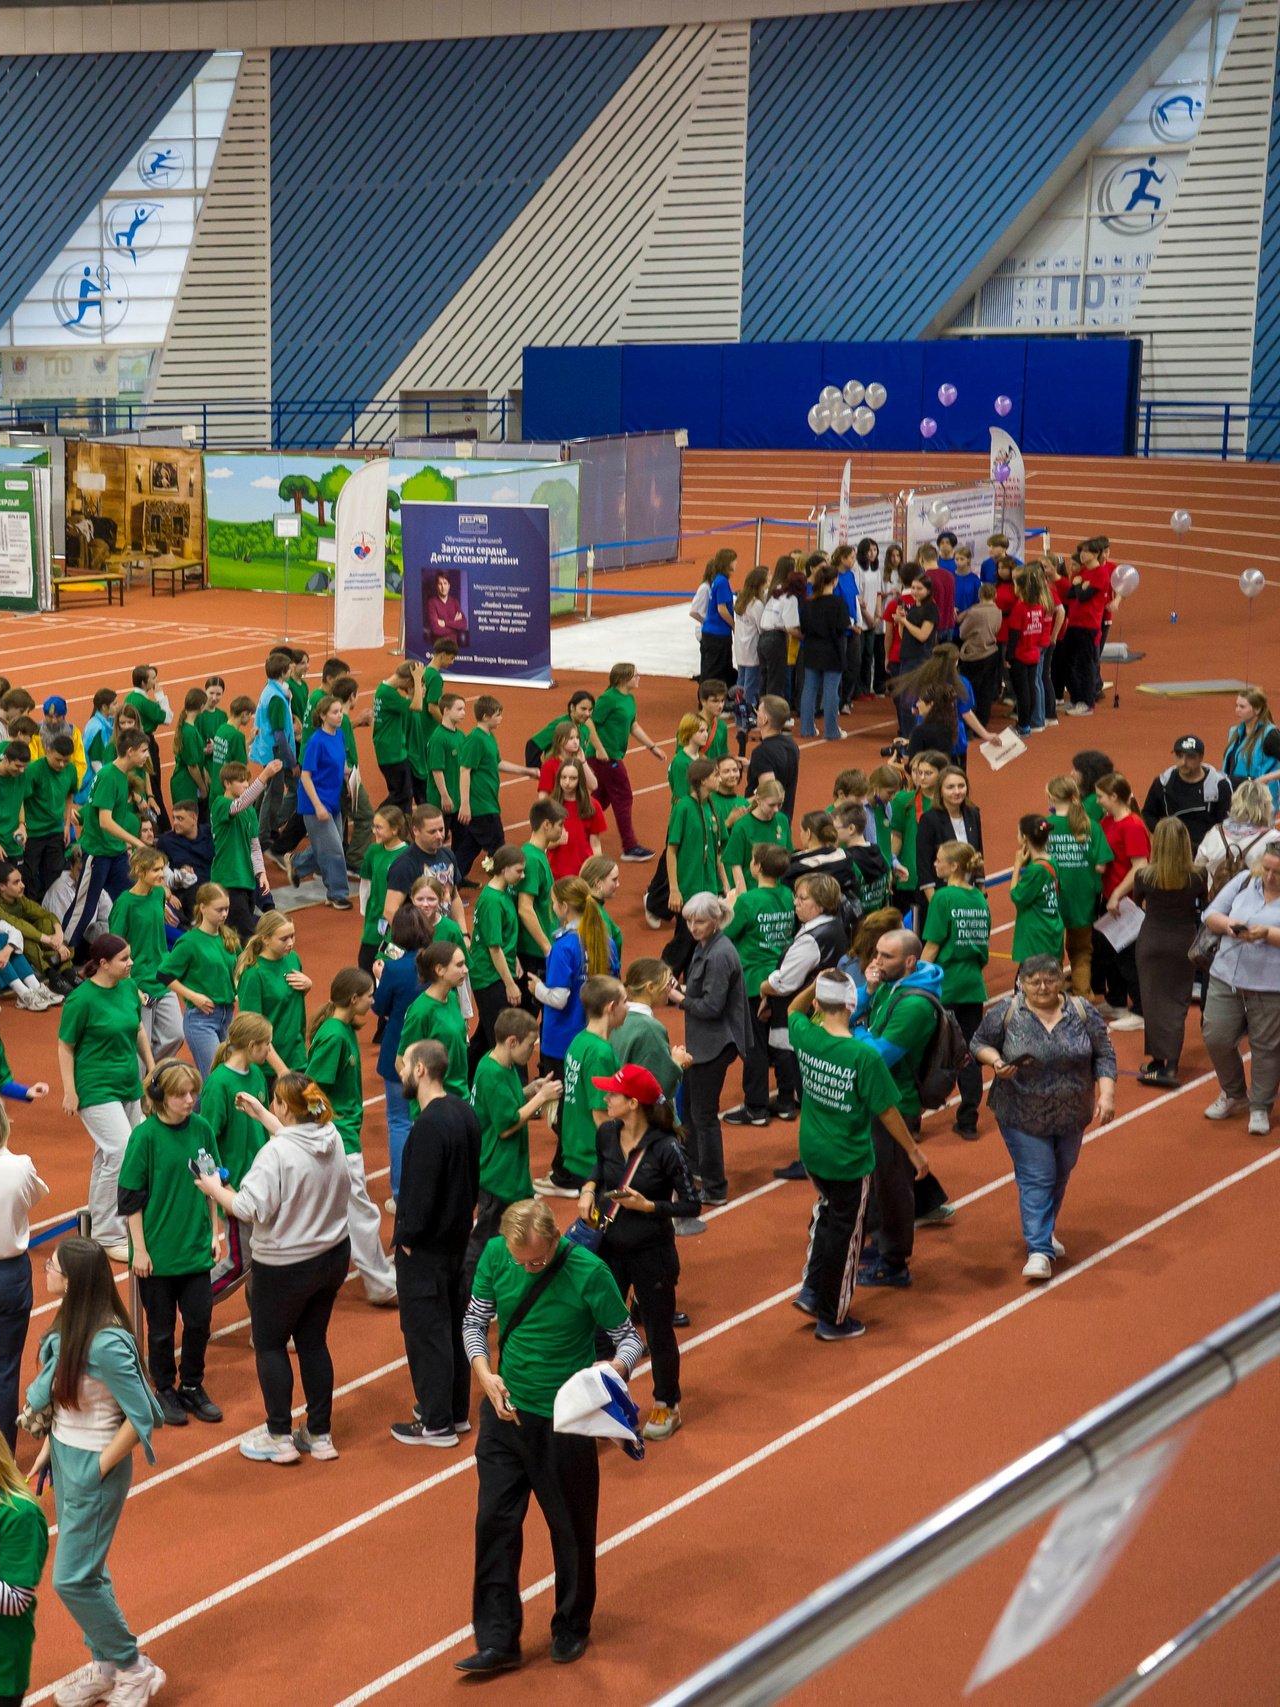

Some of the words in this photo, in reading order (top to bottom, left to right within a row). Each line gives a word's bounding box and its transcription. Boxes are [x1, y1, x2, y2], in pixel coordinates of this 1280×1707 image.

[441, 543, 474, 556] Запусти
[476, 547, 507, 557] сердце
[430, 552, 451, 564] Дети
[453, 555, 488, 564] спасают
[490, 556, 519, 566] жизни
[1056, 843, 1089, 852] ПЕРВОЙ
[810, 1069, 854, 1092] ПЕРВОЙ
